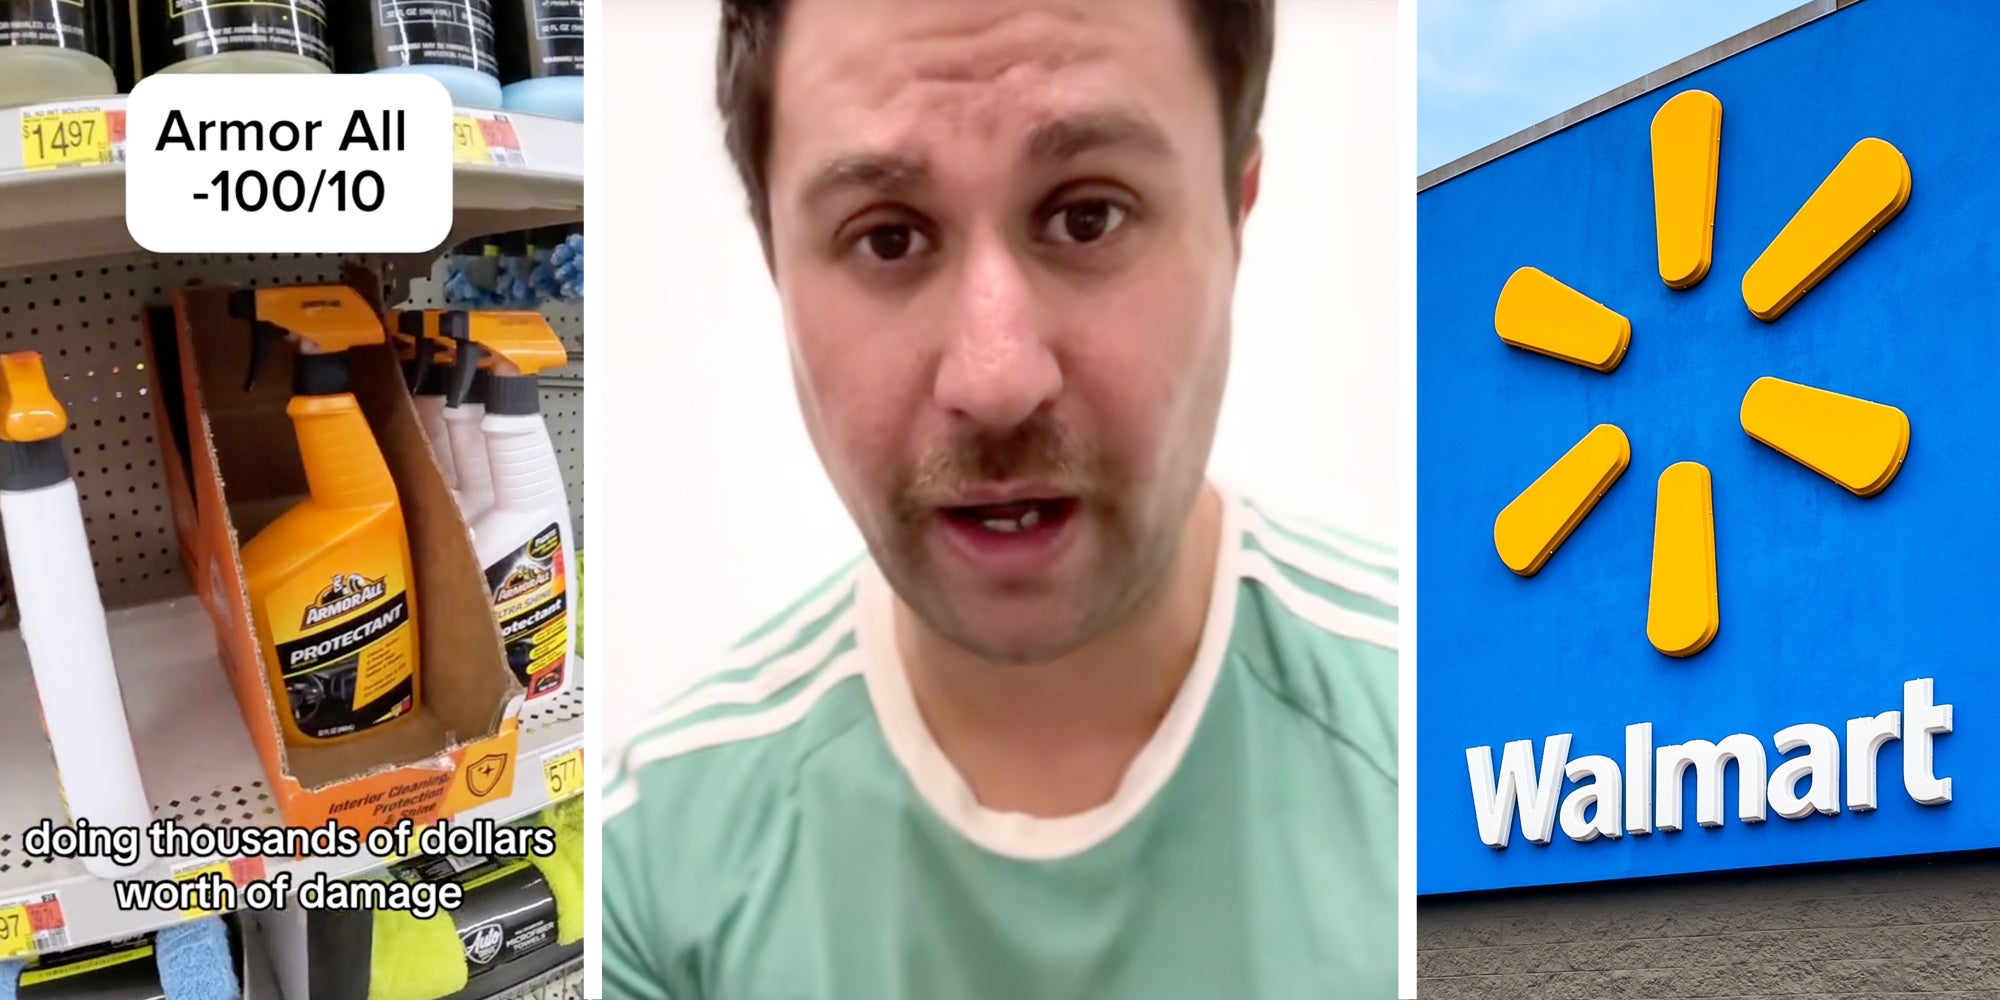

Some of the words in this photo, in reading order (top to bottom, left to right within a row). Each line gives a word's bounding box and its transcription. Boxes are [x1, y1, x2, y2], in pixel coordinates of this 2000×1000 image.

[290, 602, 404, 666] PROTECTANT
[501, 598, 562, 637] otectant
[1465, 677, 1953, 850] Walmart
[328, 791, 386, 815] Interior
[388, 773, 451, 799] Cleaning,
[373, 787, 445, 816] Protection
[401, 802, 438, 818] Shine
[466, 926, 500, 955] Auto
